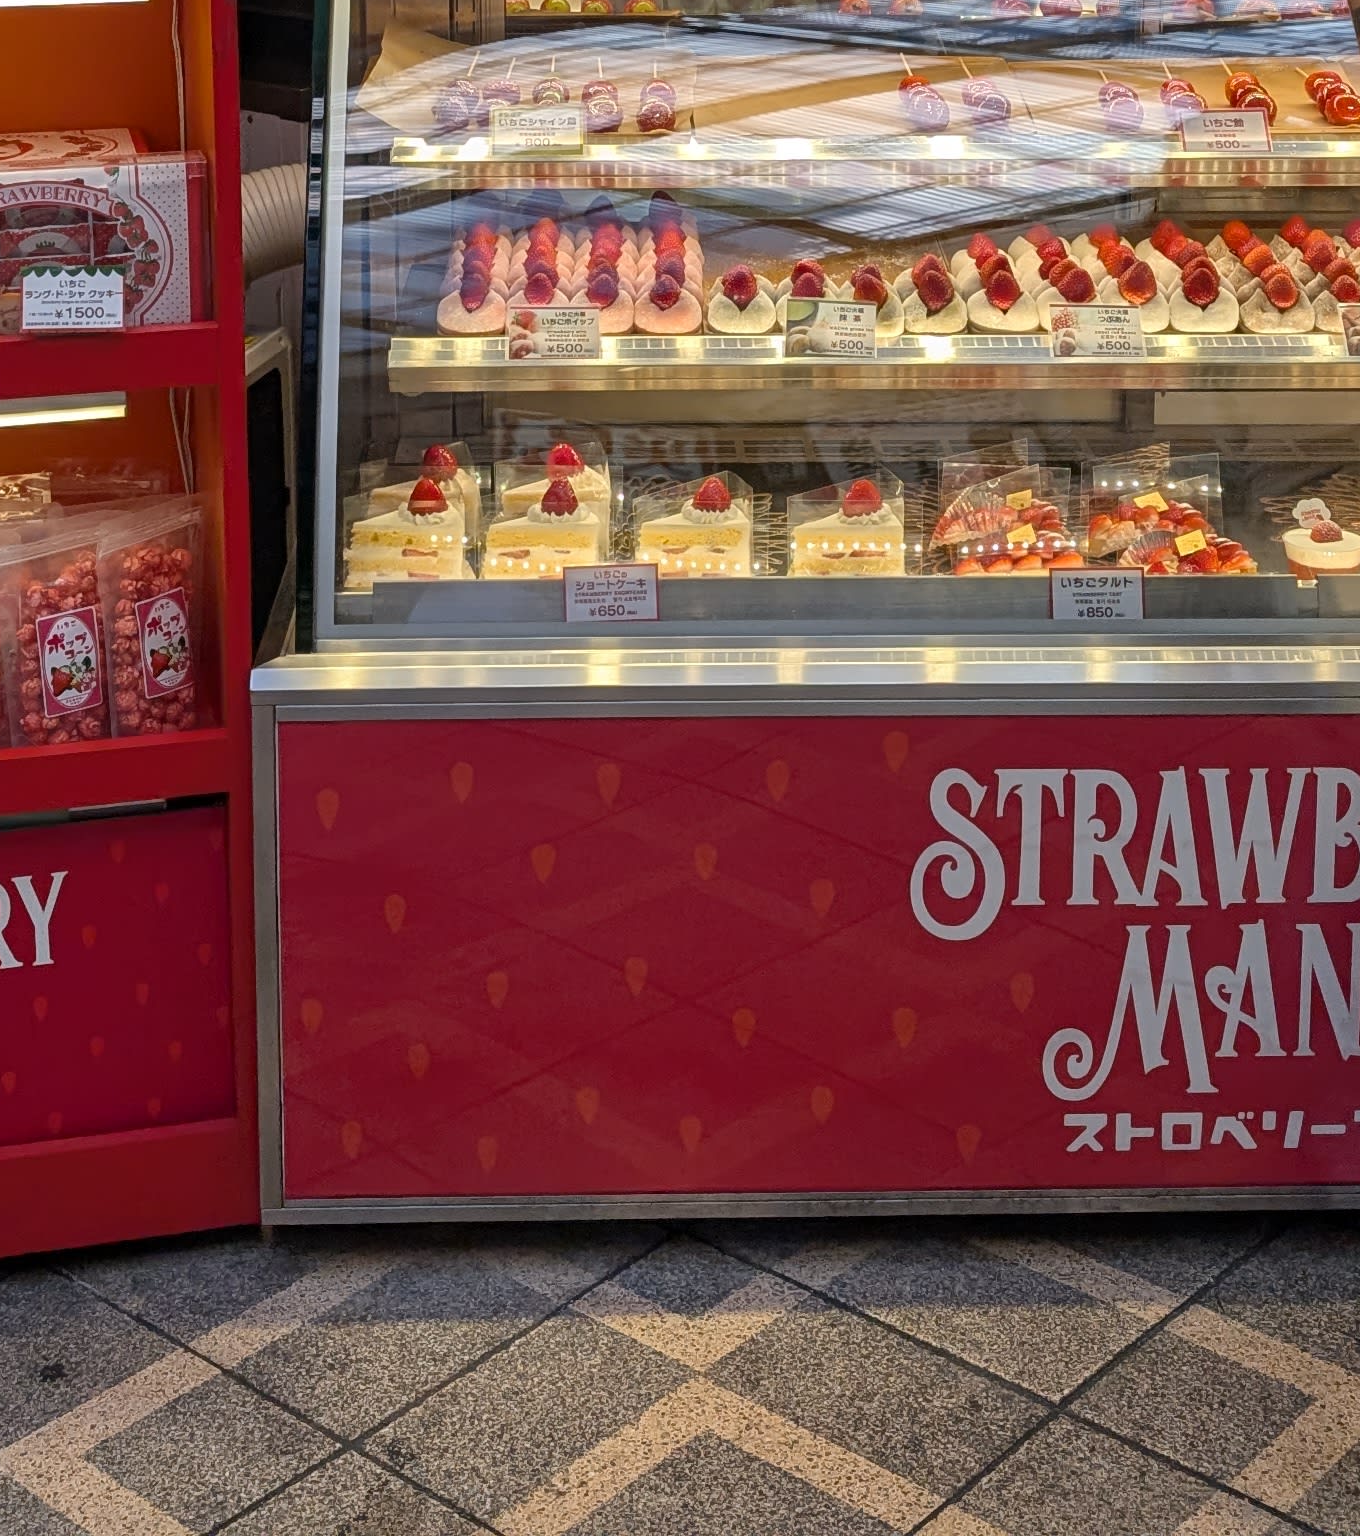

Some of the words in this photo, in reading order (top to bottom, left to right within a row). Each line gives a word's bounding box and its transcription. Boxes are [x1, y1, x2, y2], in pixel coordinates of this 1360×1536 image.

[55, 307, 104, 319] ¥1500
[547, 344, 583, 353] ¥500
[575, 579, 647, 590] ショートケーキ
[1061, 577, 1133, 588] いちごタルト
[589, 605, 625, 616] ¥650
[1077, 606, 1113, 617] ¥850
